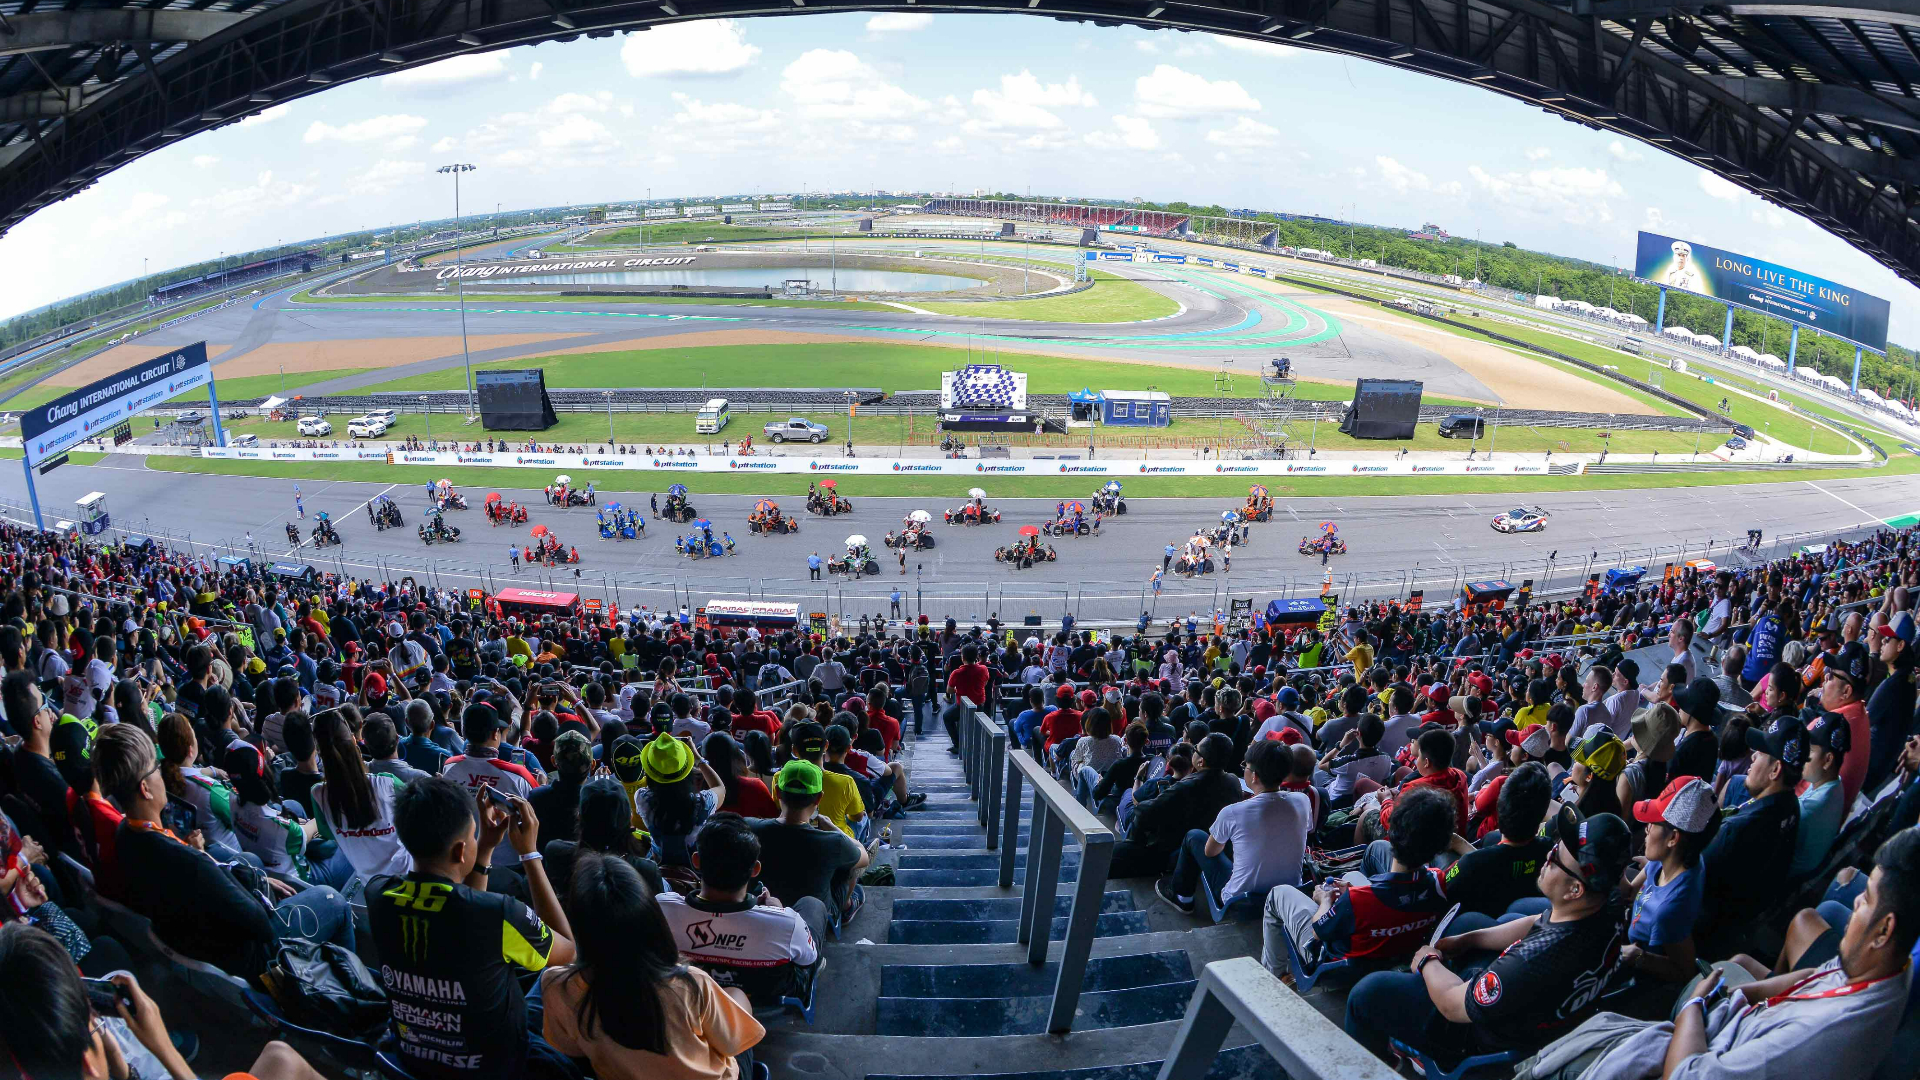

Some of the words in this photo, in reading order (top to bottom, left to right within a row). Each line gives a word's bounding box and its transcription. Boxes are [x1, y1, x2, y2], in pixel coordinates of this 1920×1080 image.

[436, 264, 500, 280] Chang
[496, 258, 617, 275] INTERNATIONAL
[623, 256, 697, 268] CIRCUIT
[1715, 257, 1752, 276] LONG
[1756, 267, 1786, 286] LIVE
[1789, 277, 1815, 295] THE
[1819, 286, 1850, 306] KING
[47, 400, 79, 423] Chang
[80, 376, 140, 408] INTERNATIONAL
[140, 361, 171, 384] CIRCUIT
[707, 605, 750, 614] PRAMAC
[752, 607, 796, 615] PRAMAC
[382, 880, 454, 913] 46
[1369, 914, 1437, 938] HONDA
[714, 933, 747, 947] NPC
[393, 969, 467, 1001] YAMAHA
[405, 1013, 462, 1033] DEPAN
[418, 1033, 464, 1047] MICHELIN
